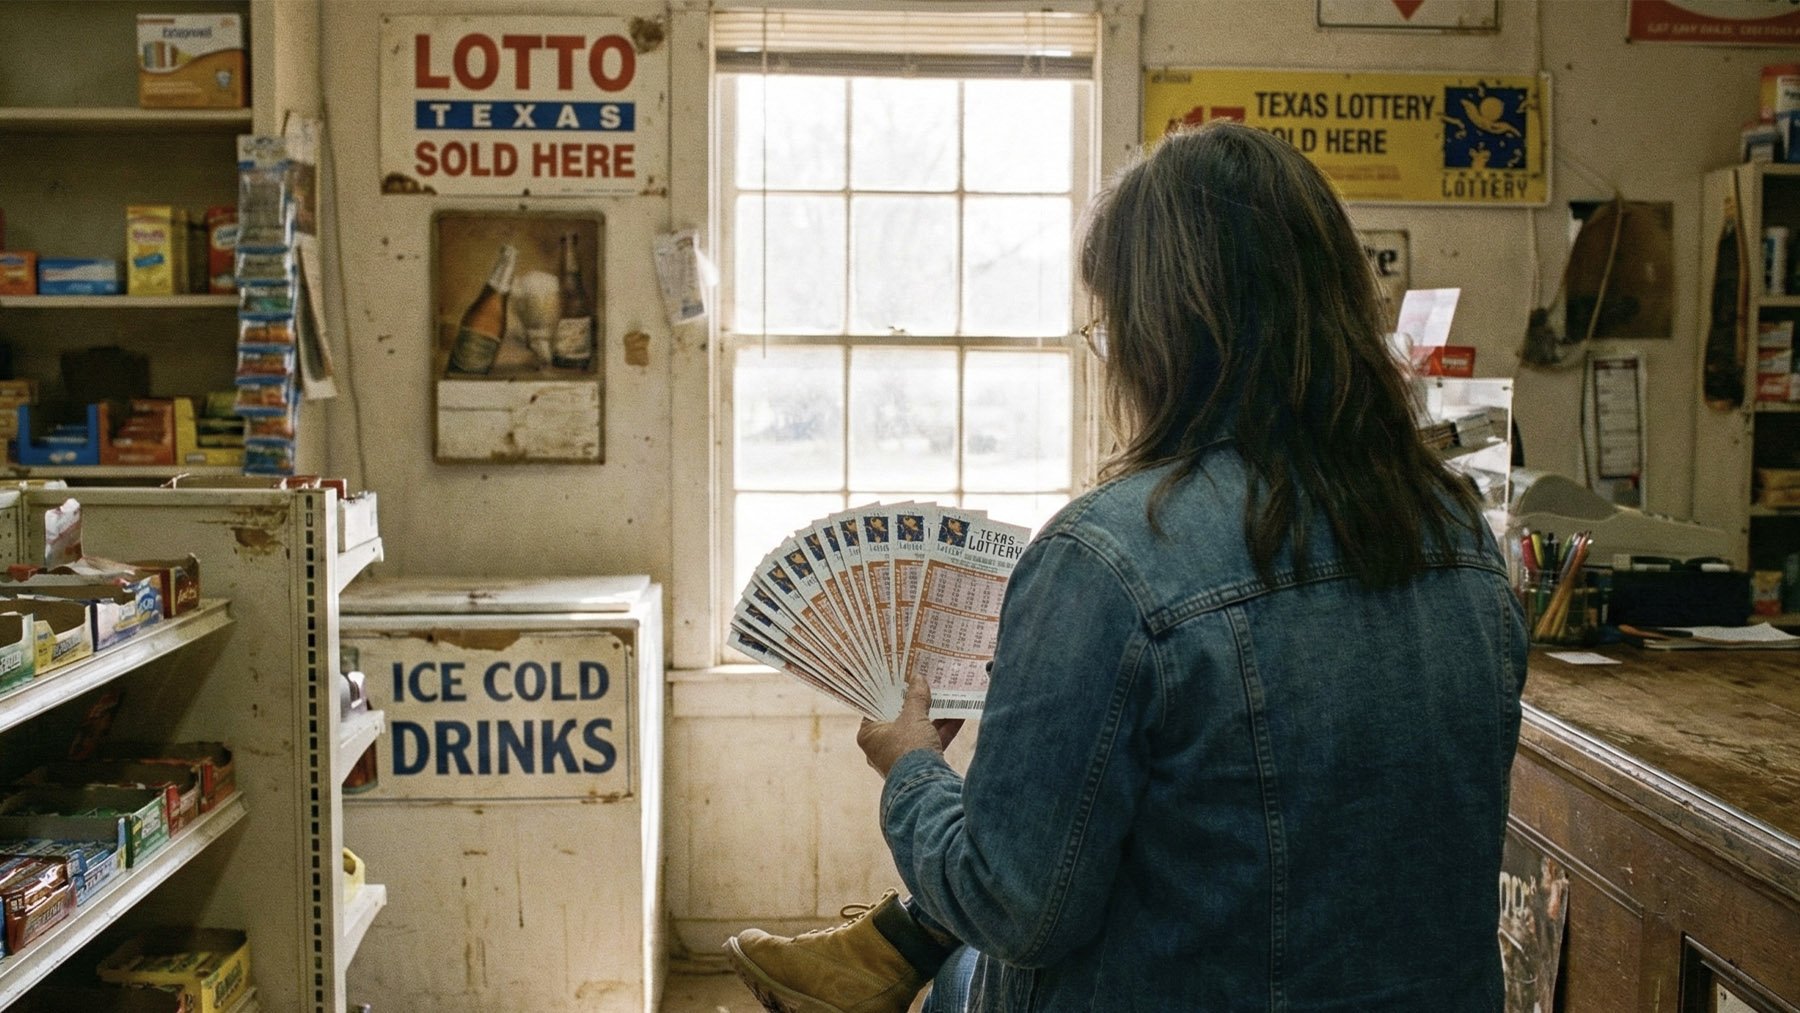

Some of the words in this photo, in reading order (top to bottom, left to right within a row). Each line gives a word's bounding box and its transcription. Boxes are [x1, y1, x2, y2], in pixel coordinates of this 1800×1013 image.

[414, 33, 637, 93] LOTTO
[429, 102, 622, 129] TEXAS
[1255, 91, 1329, 118] TEXAS
[1336, 93, 1435, 120] LOTTERY
[1326, 128, 1388, 155] HERE
[415, 141, 519, 178] SOLD
[532, 142, 636, 178] HERE
[1441, 177, 1528, 199] LOTTERY
[968, 535, 1024, 561] LOTTERY
[980, 528, 1016, 546] TEXAS
[392, 661, 467, 703] ICE
[483, 660, 610, 703] COLD
[391, 717, 618, 776] DRINKS
